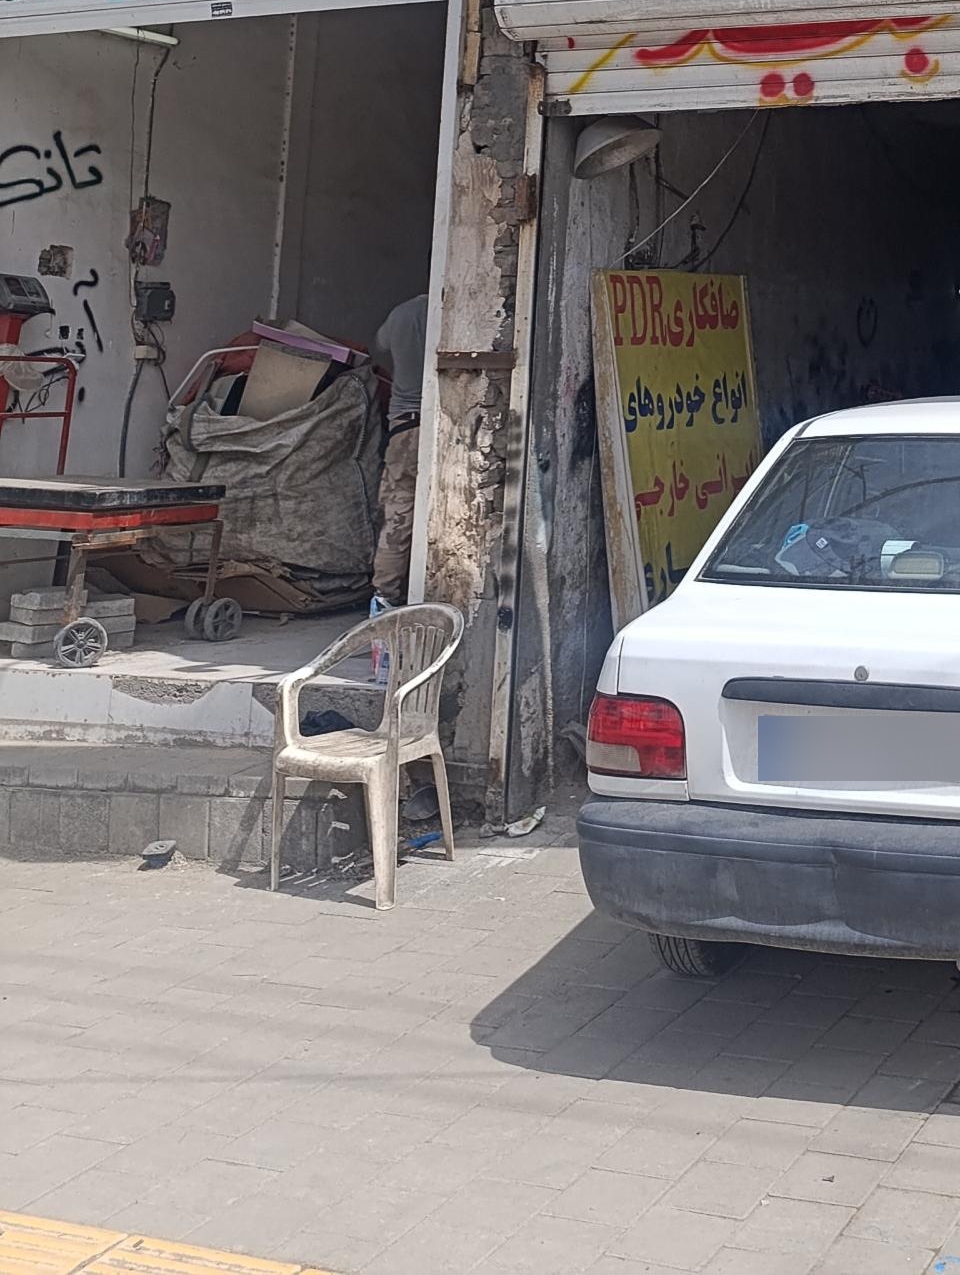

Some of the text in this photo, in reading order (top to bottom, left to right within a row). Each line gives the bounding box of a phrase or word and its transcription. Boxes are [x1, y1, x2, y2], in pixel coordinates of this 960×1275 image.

[609, 275, 741, 347] صافکاری PDR
[622, 370, 748, 433] انواع خودروهای
